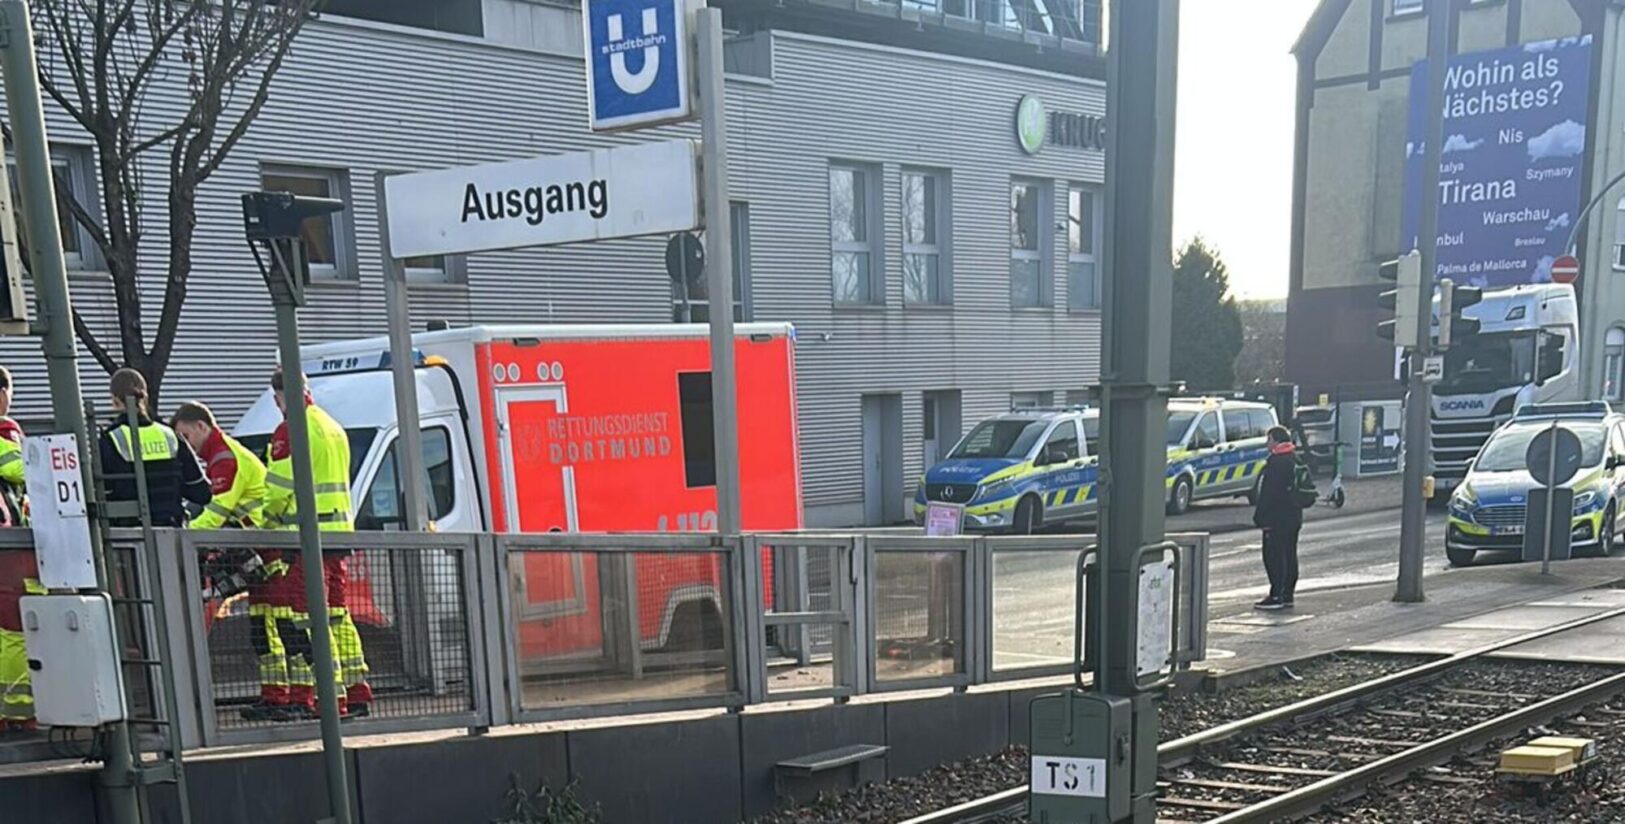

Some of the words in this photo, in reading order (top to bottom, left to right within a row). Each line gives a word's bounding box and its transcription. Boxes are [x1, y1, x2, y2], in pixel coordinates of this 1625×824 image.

[602, 34, 666, 54] stadtbahn
[1521, 53, 1558, 79] als
[1498, 128, 1524, 145] Nis
[1526, 166, 1574, 180] Szymany
[461, 178, 609, 226] Ausgang
[1438, 179, 1517, 205] Tirana
[1482, 208, 1550, 226] Warschau
[1437, 262, 1468, 275] Palma
[1469, 261, 1482, 273] de
[1483, 258, 1528, 272] Mallorca
[322, 359, 343, 371] RTW
[345, 357, 359, 369] 59
[1440, 399, 1485, 412] SCANIA
[51, 447, 78, 471] Eis
[550, 435, 672, 464] DORTMUND
[57, 480, 81, 502] D1
